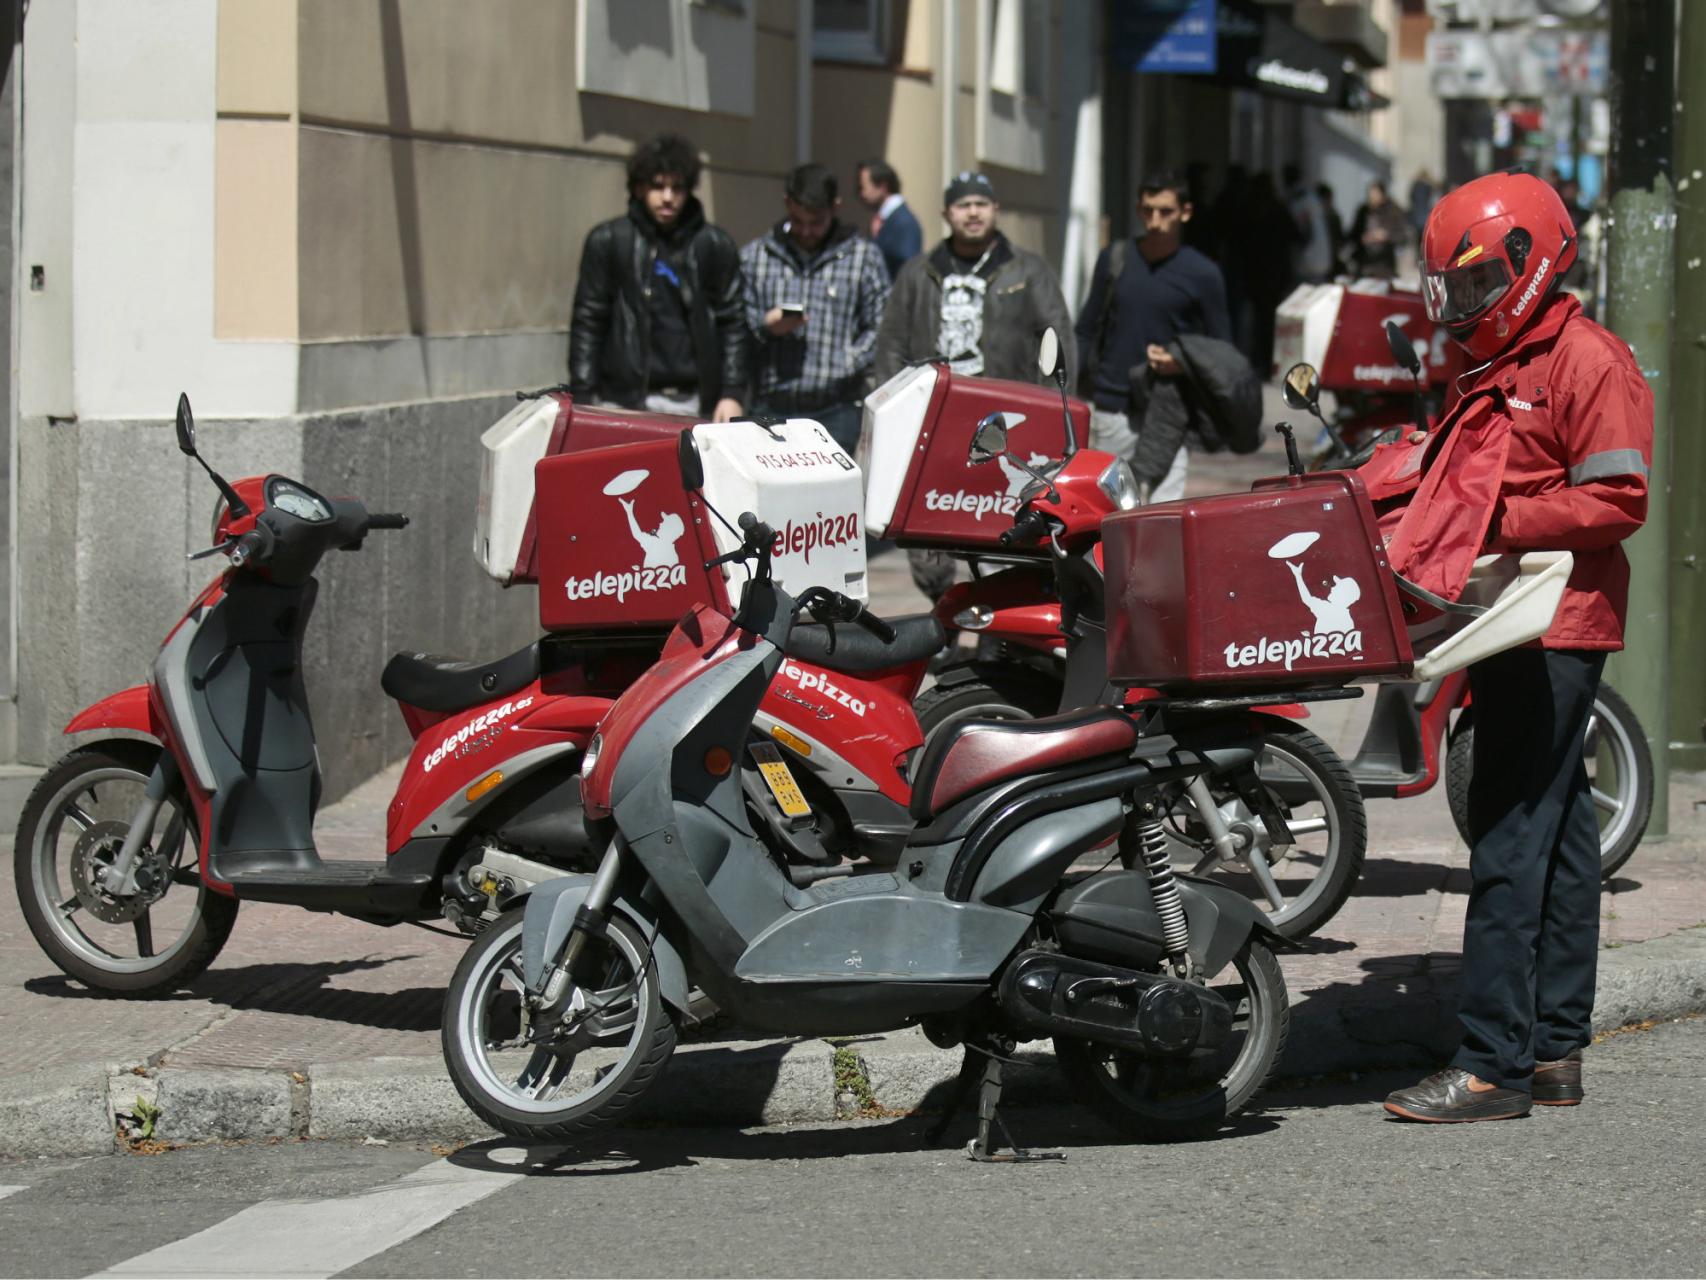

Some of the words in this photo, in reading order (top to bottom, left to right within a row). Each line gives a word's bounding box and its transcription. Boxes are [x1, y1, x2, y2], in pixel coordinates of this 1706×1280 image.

[1511, 257, 1551, 317] telepizza
[925, 489, 1022, 521] telepiz
[770, 511, 859, 566] elepizza
[564, 564, 687, 604] telepizza
[1223, 630, 1363, 672] telepizza
[777, 657, 867, 718] lepizza
[423, 696, 534, 773] telepizza.es
